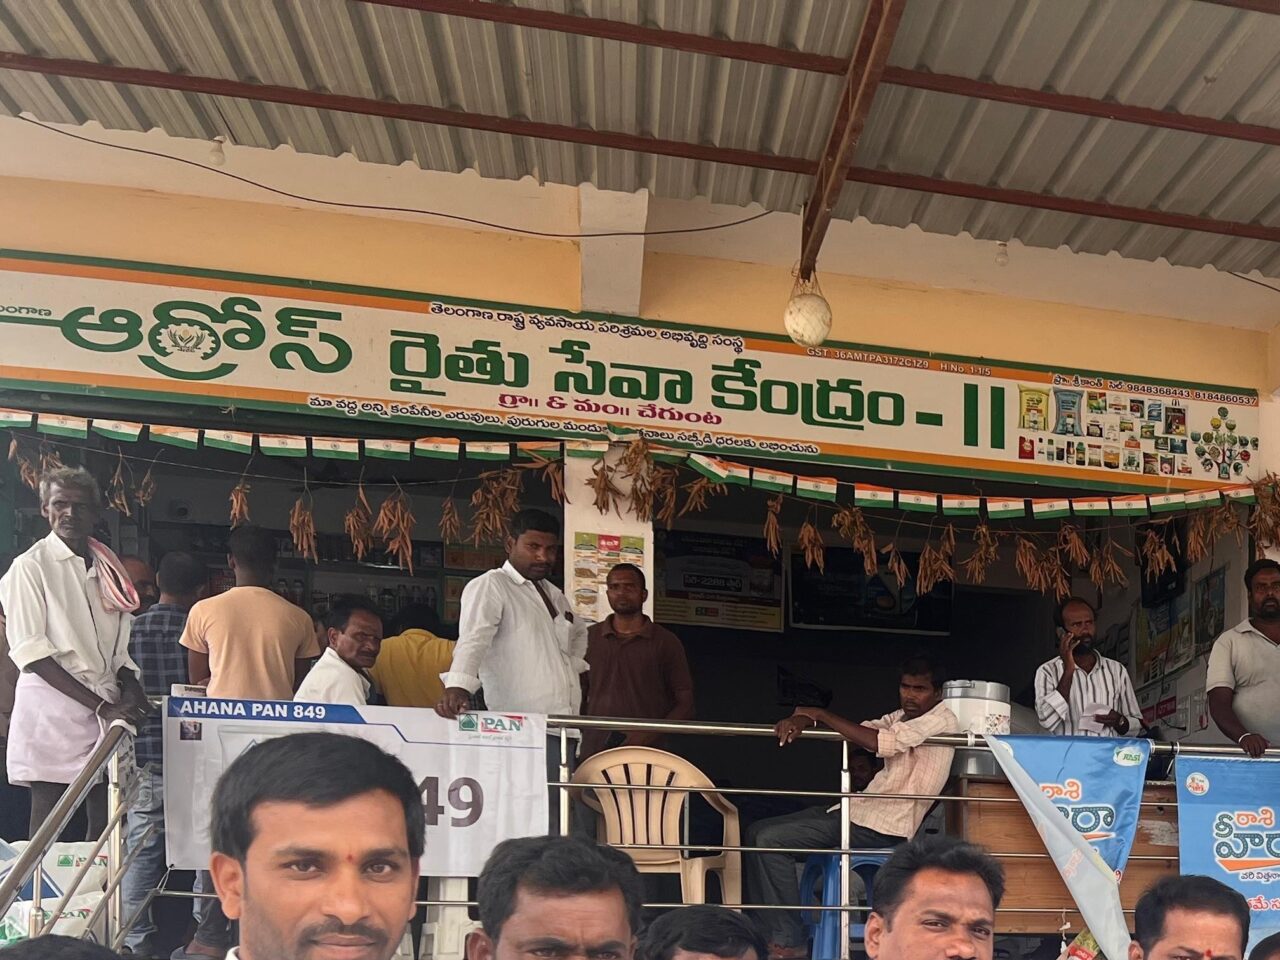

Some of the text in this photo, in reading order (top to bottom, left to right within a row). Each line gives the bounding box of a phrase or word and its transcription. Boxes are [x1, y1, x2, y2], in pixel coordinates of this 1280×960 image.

[430, 302, 494, 319] తెలంగాణ
[497, 312, 525, 330] రాష్ట్ర
[529, 315, 595, 331] వ్యవసాయ
[598, 322, 657, 338] పరిశ్రమల
[711, 335, 744, 354] సంస్థ
[389, 329, 529, 397] రైతు
[549, 339, 693, 404] సేవా
[711, 357, 905, 431] కేంద్రం
[310, 397, 332, 408] మా
[336, 399, 358, 415] వద్ద
[361, 401, 388, 416] అన్ని
[507, 415, 560, 430] పురుగుల
[716, 436, 756, 449] ధరలకు
[637, 403, 722, 426] చేగుంట
[179, 701, 326, 719] AHANA PAN 849
[482, 717, 521, 732] PAN
[421, 776, 484, 828] 49
[1236, 808, 1274, 827] రాశి
[1240, 872, 1255, 880] వరి
